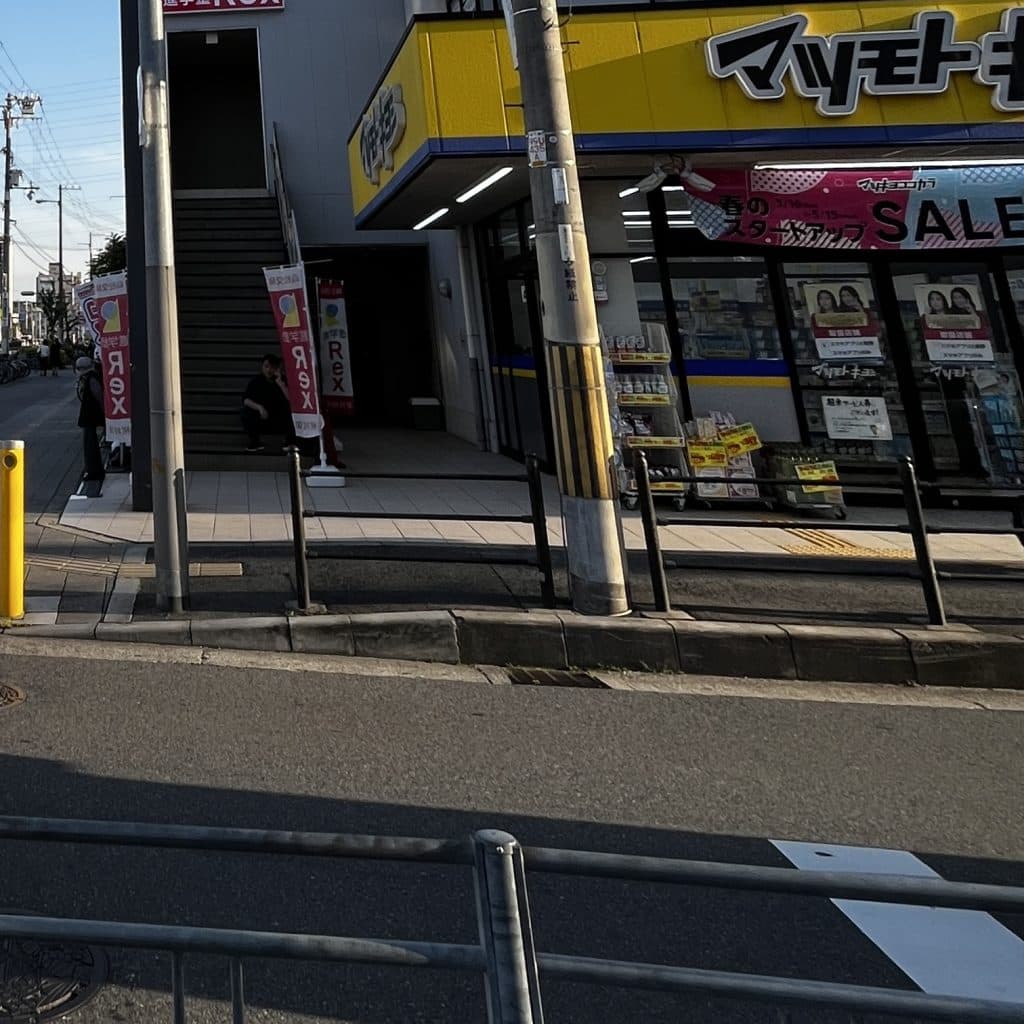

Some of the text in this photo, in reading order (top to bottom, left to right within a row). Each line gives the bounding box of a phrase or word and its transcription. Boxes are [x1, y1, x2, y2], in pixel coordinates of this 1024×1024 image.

[719, 194, 769, 218] 春の
[872, 195, 1024, 243] SALE
[726, 219, 865, 244] スタートアップ
[328, 340, 345, 392] Rex
